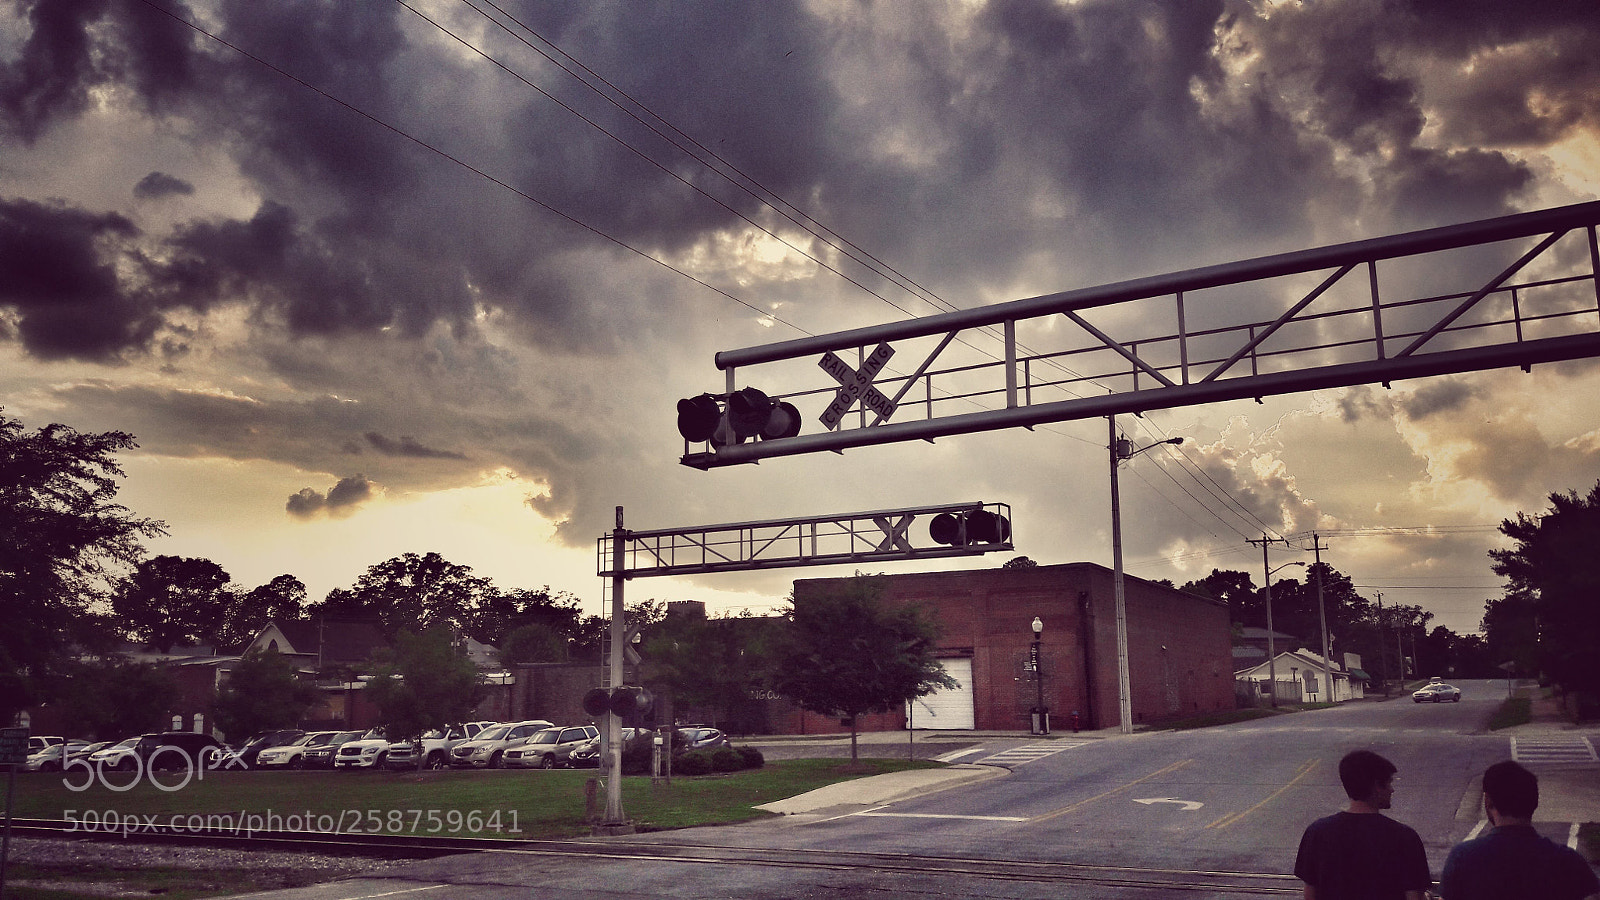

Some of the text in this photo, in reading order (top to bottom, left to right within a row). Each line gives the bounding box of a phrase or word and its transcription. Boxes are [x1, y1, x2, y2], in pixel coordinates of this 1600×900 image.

[821, 353, 893, 417] RAIL ROAD
[825, 347, 888, 423] CROSSING
